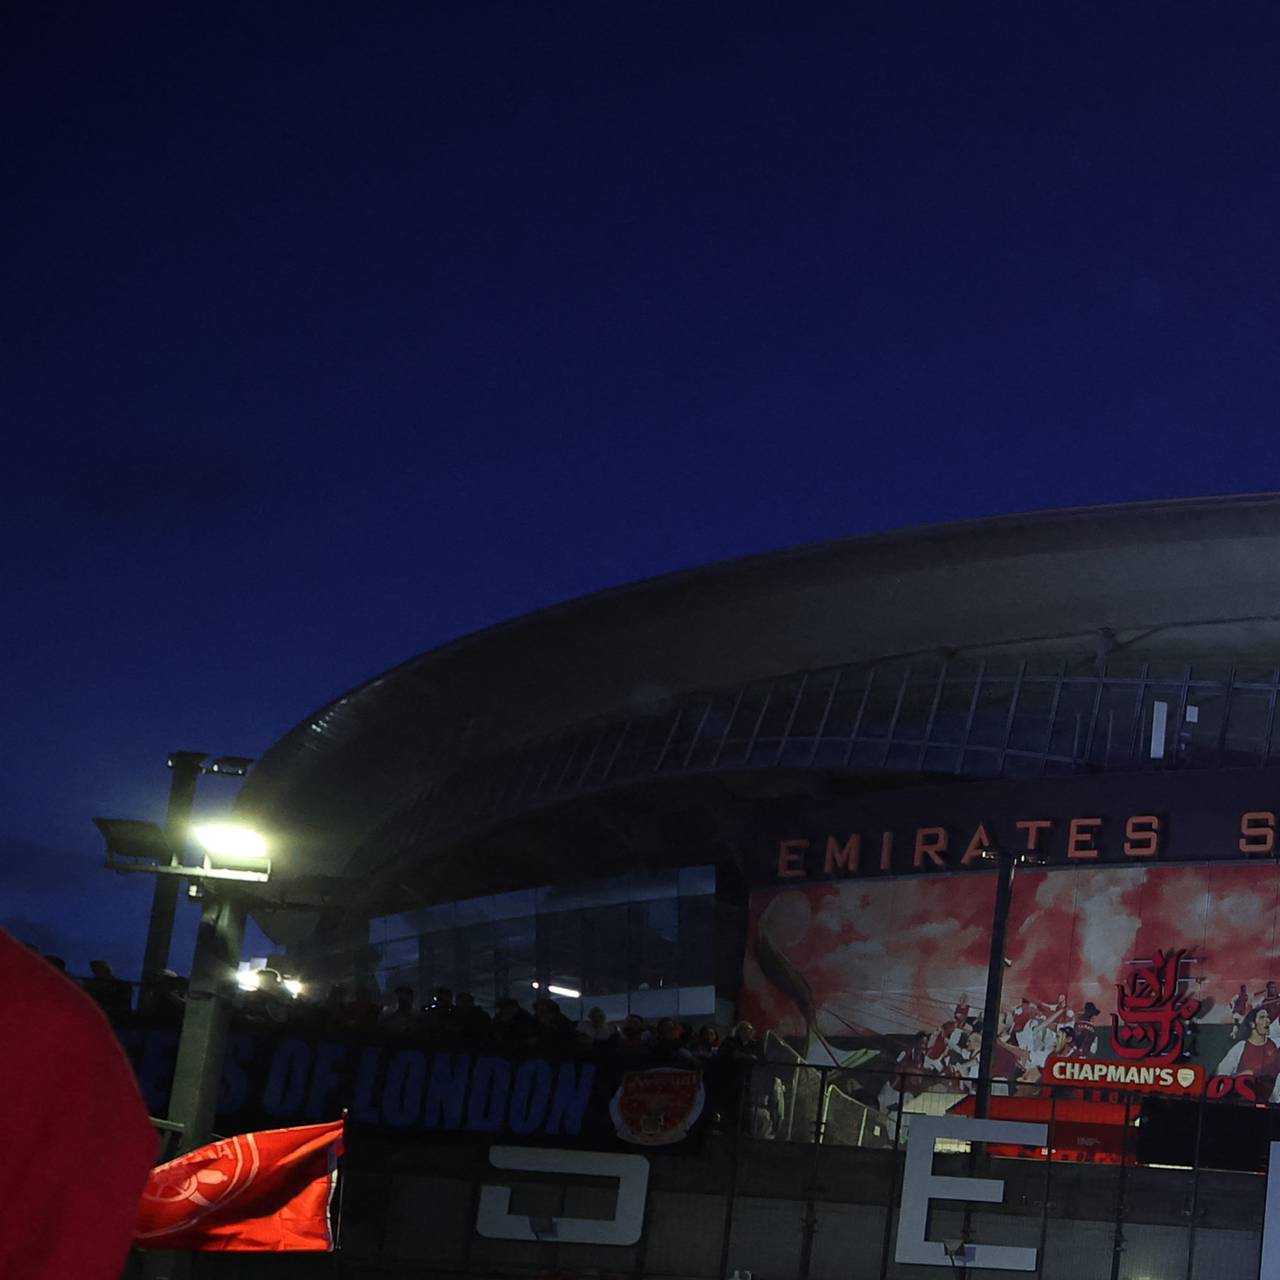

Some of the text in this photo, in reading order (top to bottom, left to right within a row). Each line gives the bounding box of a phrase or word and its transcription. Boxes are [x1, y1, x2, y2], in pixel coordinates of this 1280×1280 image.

[777, 814, 1160, 878] EMIRATES
[263, 1038, 352, 1118] OF
[353, 1048, 597, 1138] LONDON
[1052, 1061, 1175, 1086] CHAPMAN'S
